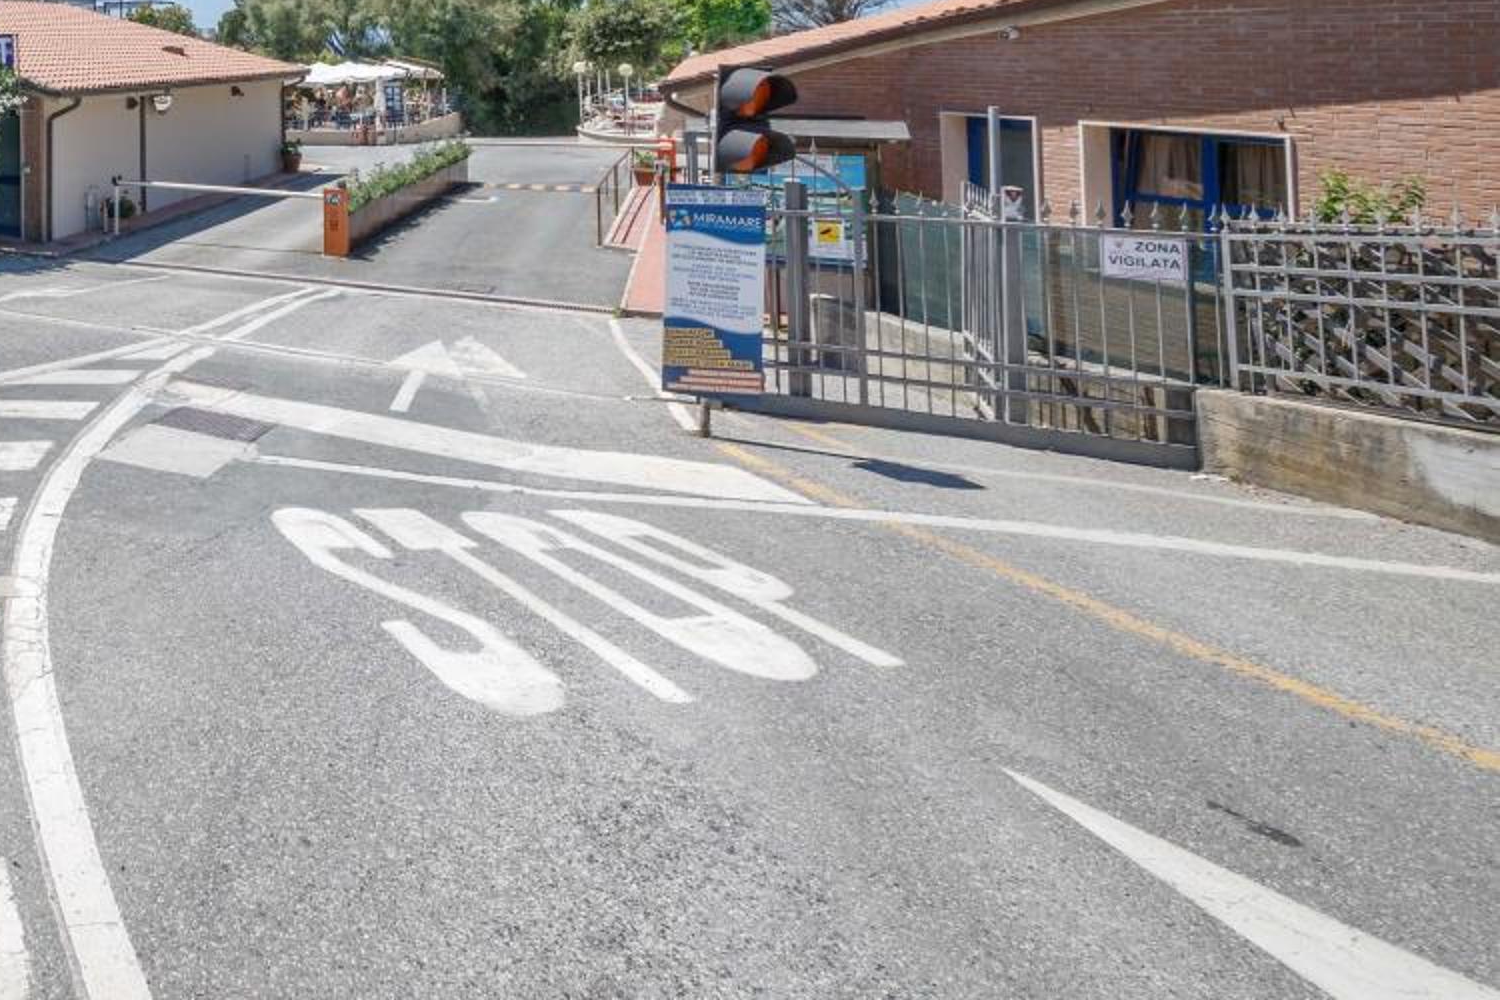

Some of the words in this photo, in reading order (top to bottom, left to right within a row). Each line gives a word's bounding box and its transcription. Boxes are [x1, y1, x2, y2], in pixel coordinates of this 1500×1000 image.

[693, 212, 763, 229] MIRAMARE
[1134, 241, 1181, 255] ZONA
[1108, 255, 1180, 269] VIGILATA
[271, 508, 905, 717] STOP
